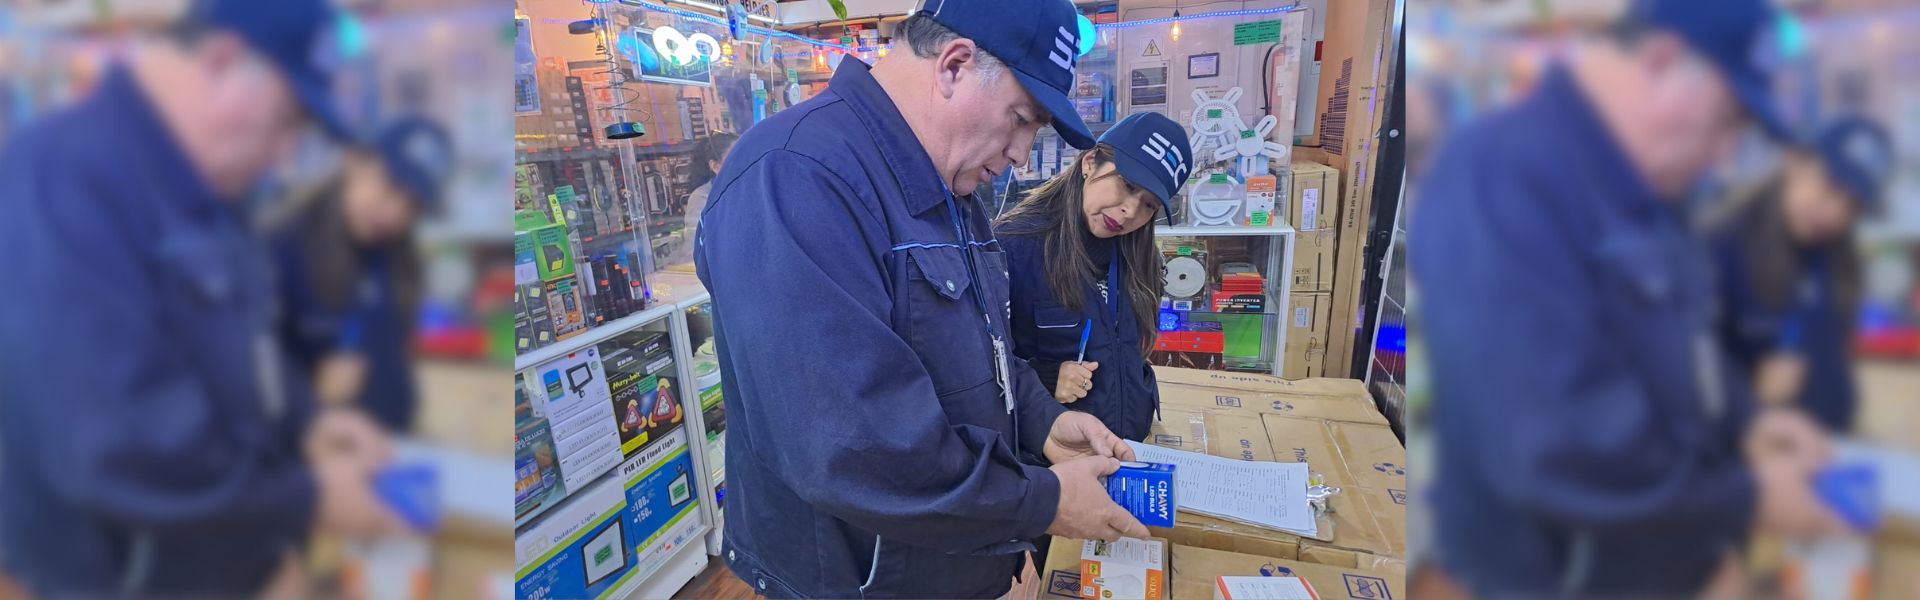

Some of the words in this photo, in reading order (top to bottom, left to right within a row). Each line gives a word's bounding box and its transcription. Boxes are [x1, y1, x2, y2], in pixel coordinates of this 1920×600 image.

[1158, 480, 1168, 520] CHAWY
[553, 523, 579, 543] Outdoor
[580, 511, 596, 525] Light
[520, 568, 545, 590] ENERGY
[547, 553, 569, 571] SAVING
